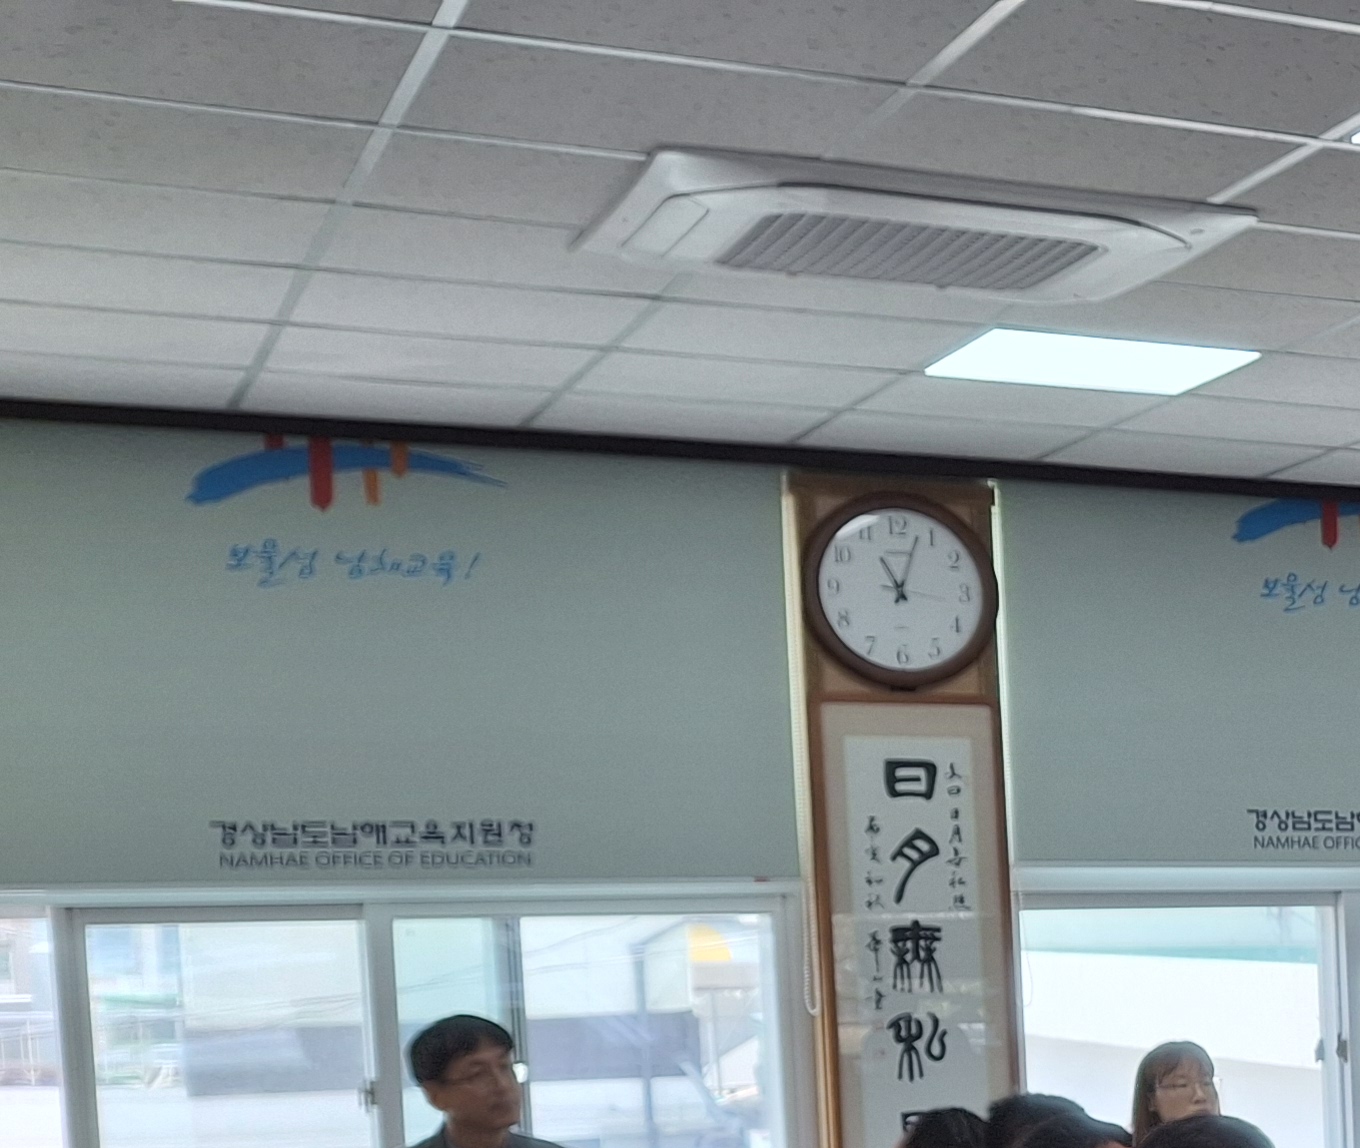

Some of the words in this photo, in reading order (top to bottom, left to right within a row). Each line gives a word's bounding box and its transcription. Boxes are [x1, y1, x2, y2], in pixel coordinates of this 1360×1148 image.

[889, 515, 907, 535] 12
[834, 545, 851, 563] 10
[948, 552, 960, 570] 2
[827, 578, 840, 596] 9
[865, 635, 876, 655] 7
[1253, 835, 1319, 850] NAMHAE
[220, 850, 309, 869] NAMHAE
[315, 850, 383, 869] OFFICE
[388, 850, 415, 868] OF
[420, 850, 532, 868] EDUCATION
